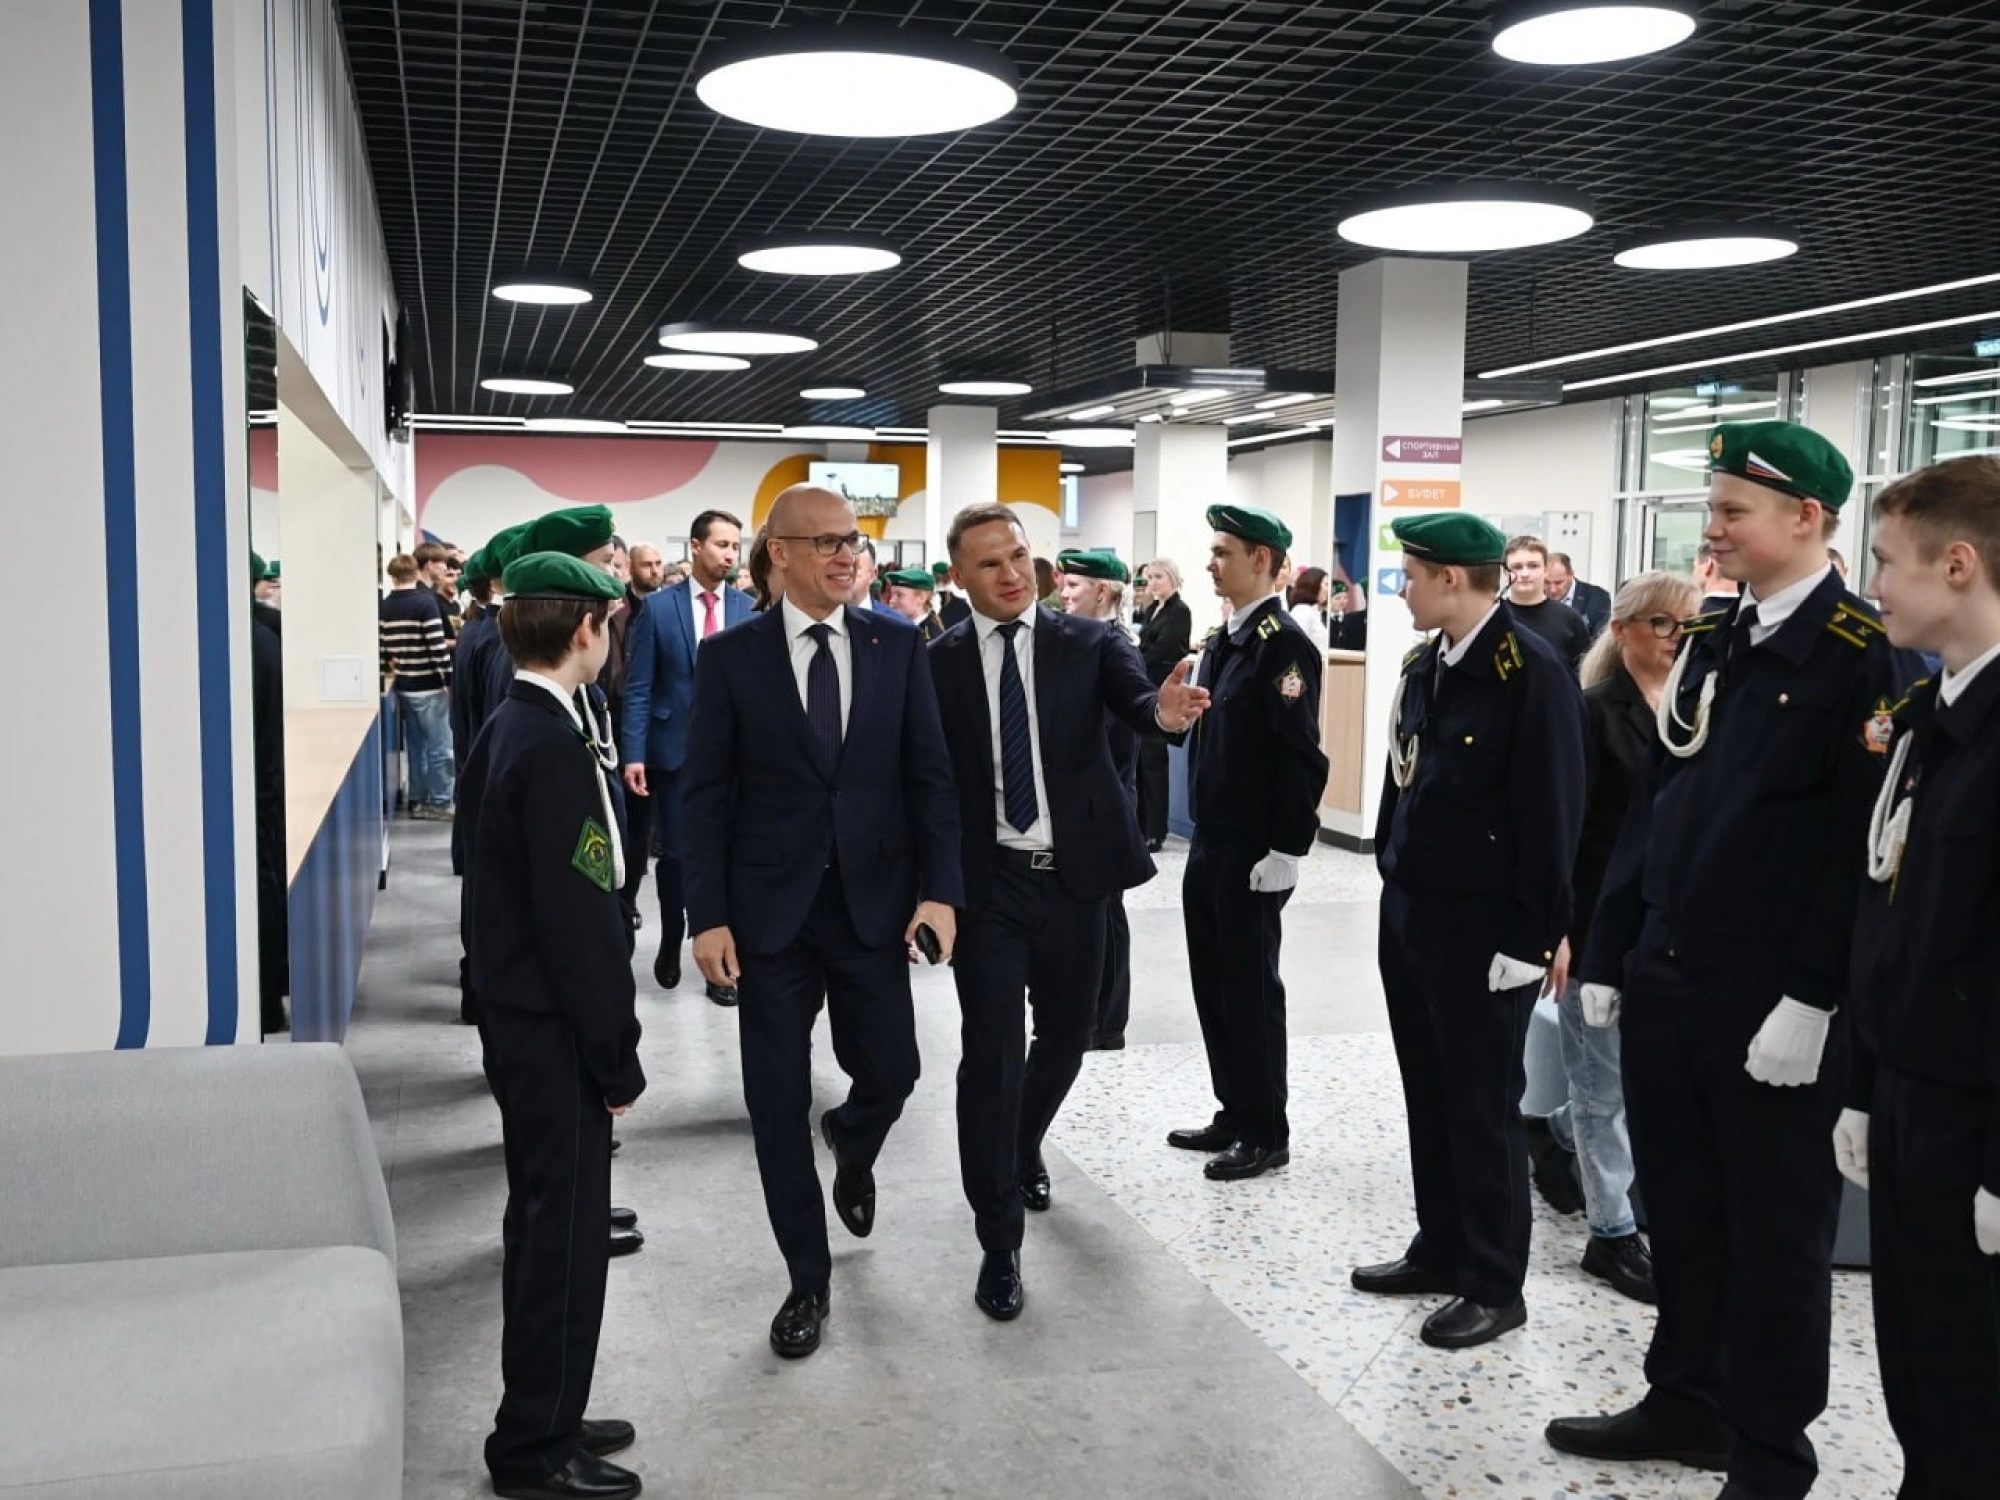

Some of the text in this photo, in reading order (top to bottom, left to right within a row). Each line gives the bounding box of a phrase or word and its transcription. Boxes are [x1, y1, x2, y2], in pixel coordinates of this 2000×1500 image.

[1402, 441, 1459, 451] СПОРТИВНЫЙ
[1422, 451, 1438, 459] ЗАЛ
[1407, 488, 1445, 500] БУФЕТ
